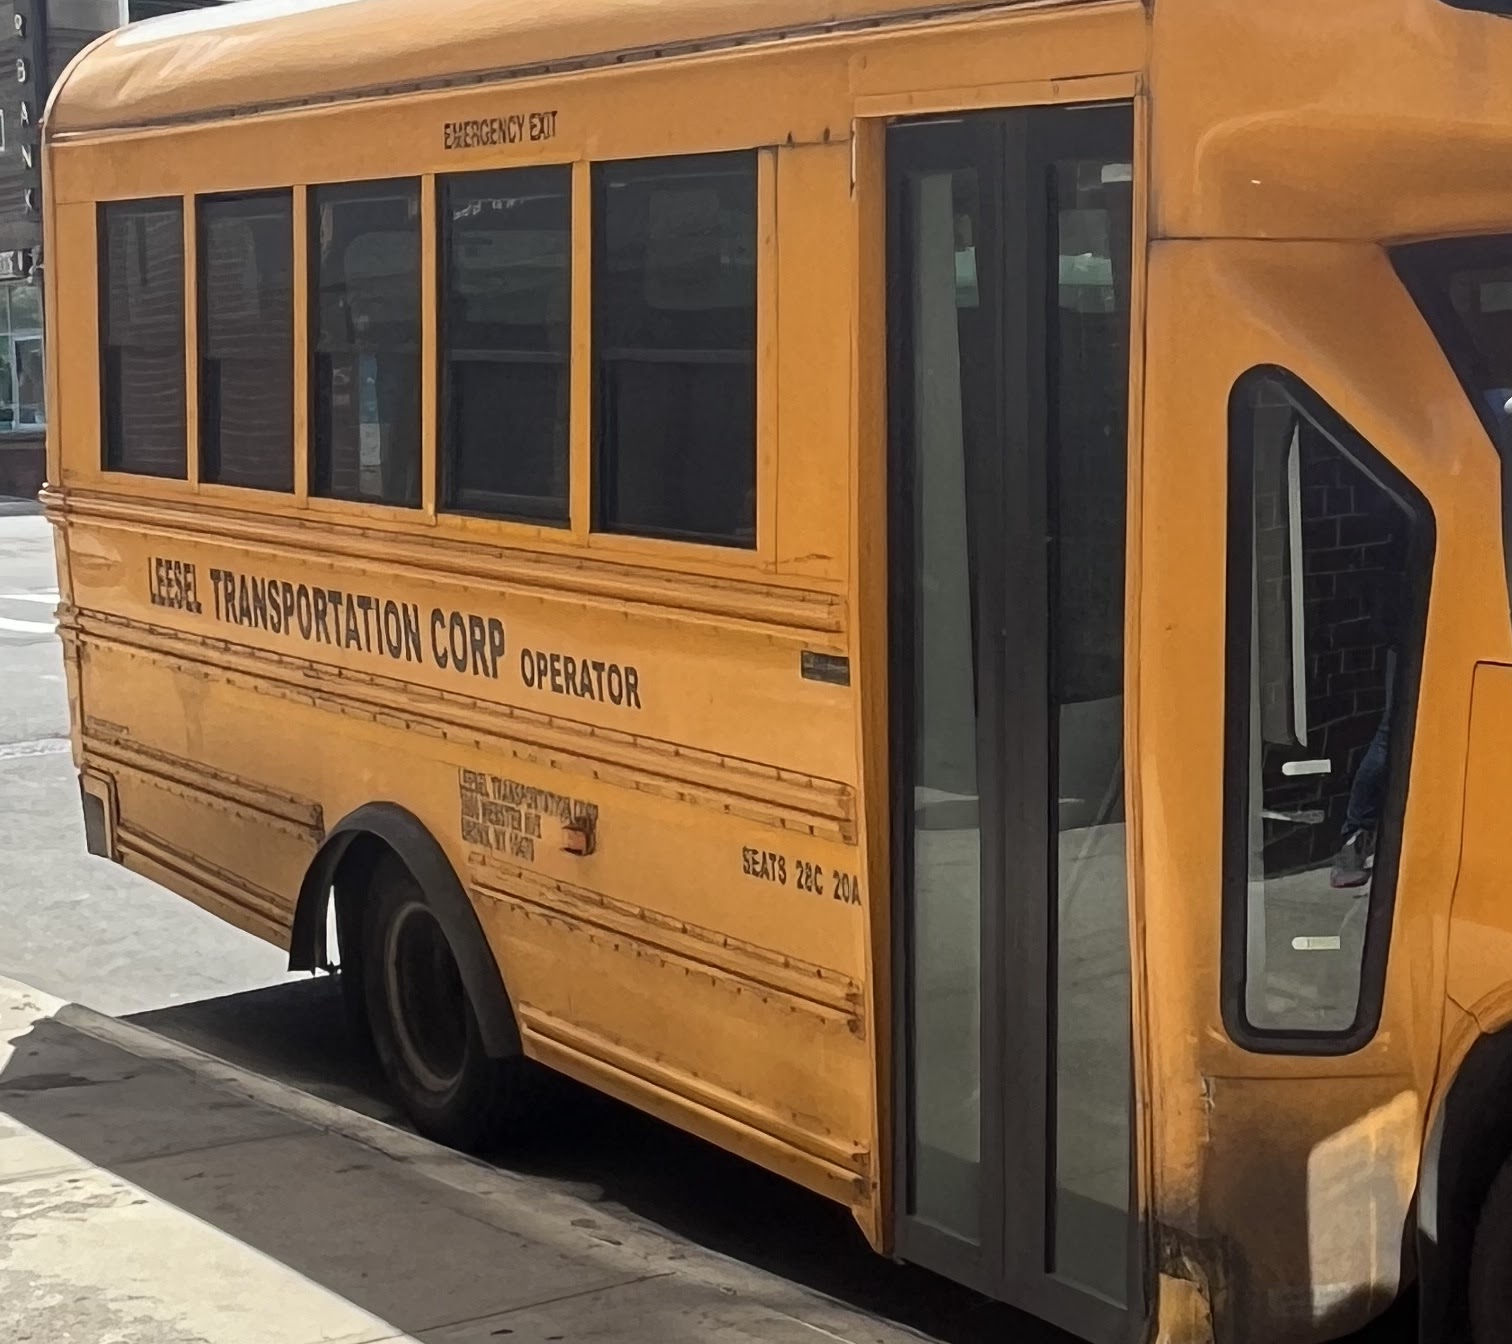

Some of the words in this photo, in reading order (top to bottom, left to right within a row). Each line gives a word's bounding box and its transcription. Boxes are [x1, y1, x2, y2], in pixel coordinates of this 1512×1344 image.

[444, 114, 525, 150] EMERGENCY
[529, 110, 558, 141] EXIT
[148, 556, 202, 615] LEESEL
[210, 568, 423, 664] TRANSPORTATION
[430, 608, 505, 679] CORP
[521, 648, 642, 710] OPERATOR
[742, 845, 787, 886] SEATS
[832, 869, 863, 906] 20A
